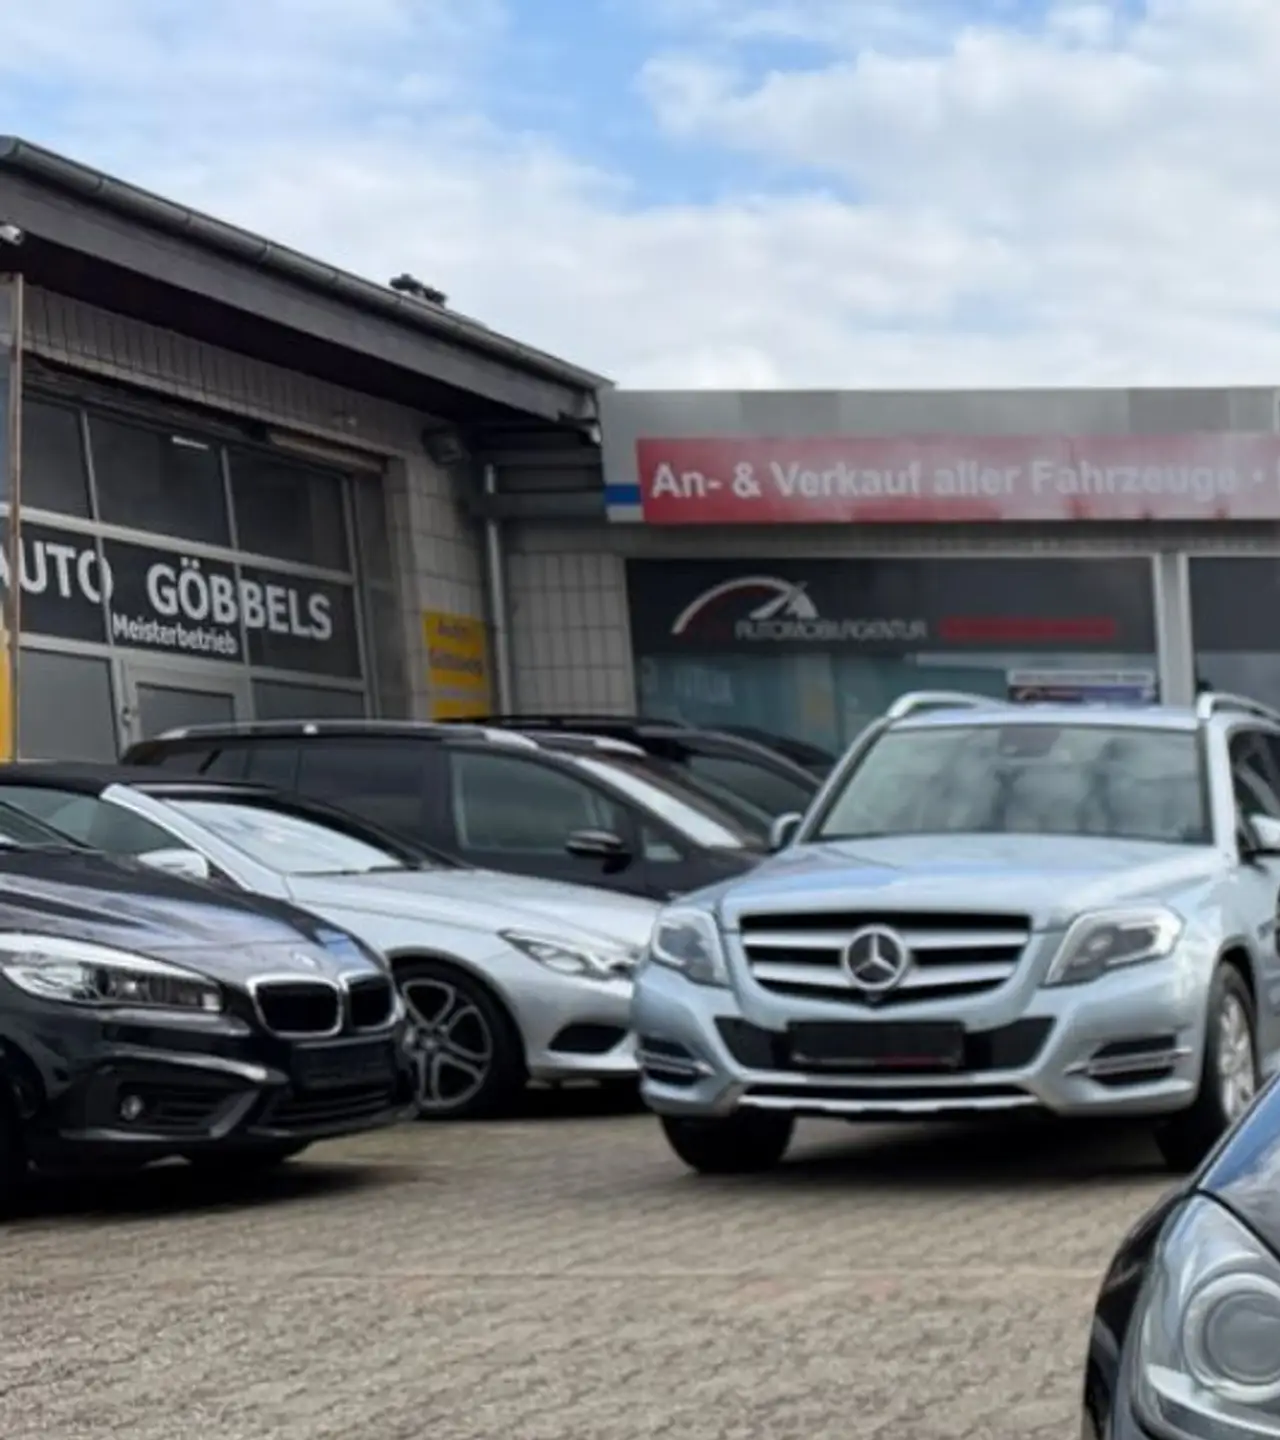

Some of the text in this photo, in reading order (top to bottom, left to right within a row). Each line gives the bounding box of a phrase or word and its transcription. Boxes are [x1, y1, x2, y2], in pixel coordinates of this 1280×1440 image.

[652, 461, 722, 498] An-
[732, 462, 761, 498] &
[770, 460, 921, 498] Verkauf
[933, 460, 1021, 497] aller
[1030, 459, 1238, 502] Fahrzeuge
[146, 556, 334, 641] GÖBBELS
[112, 611, 238, 655] Meisterbetrieb
